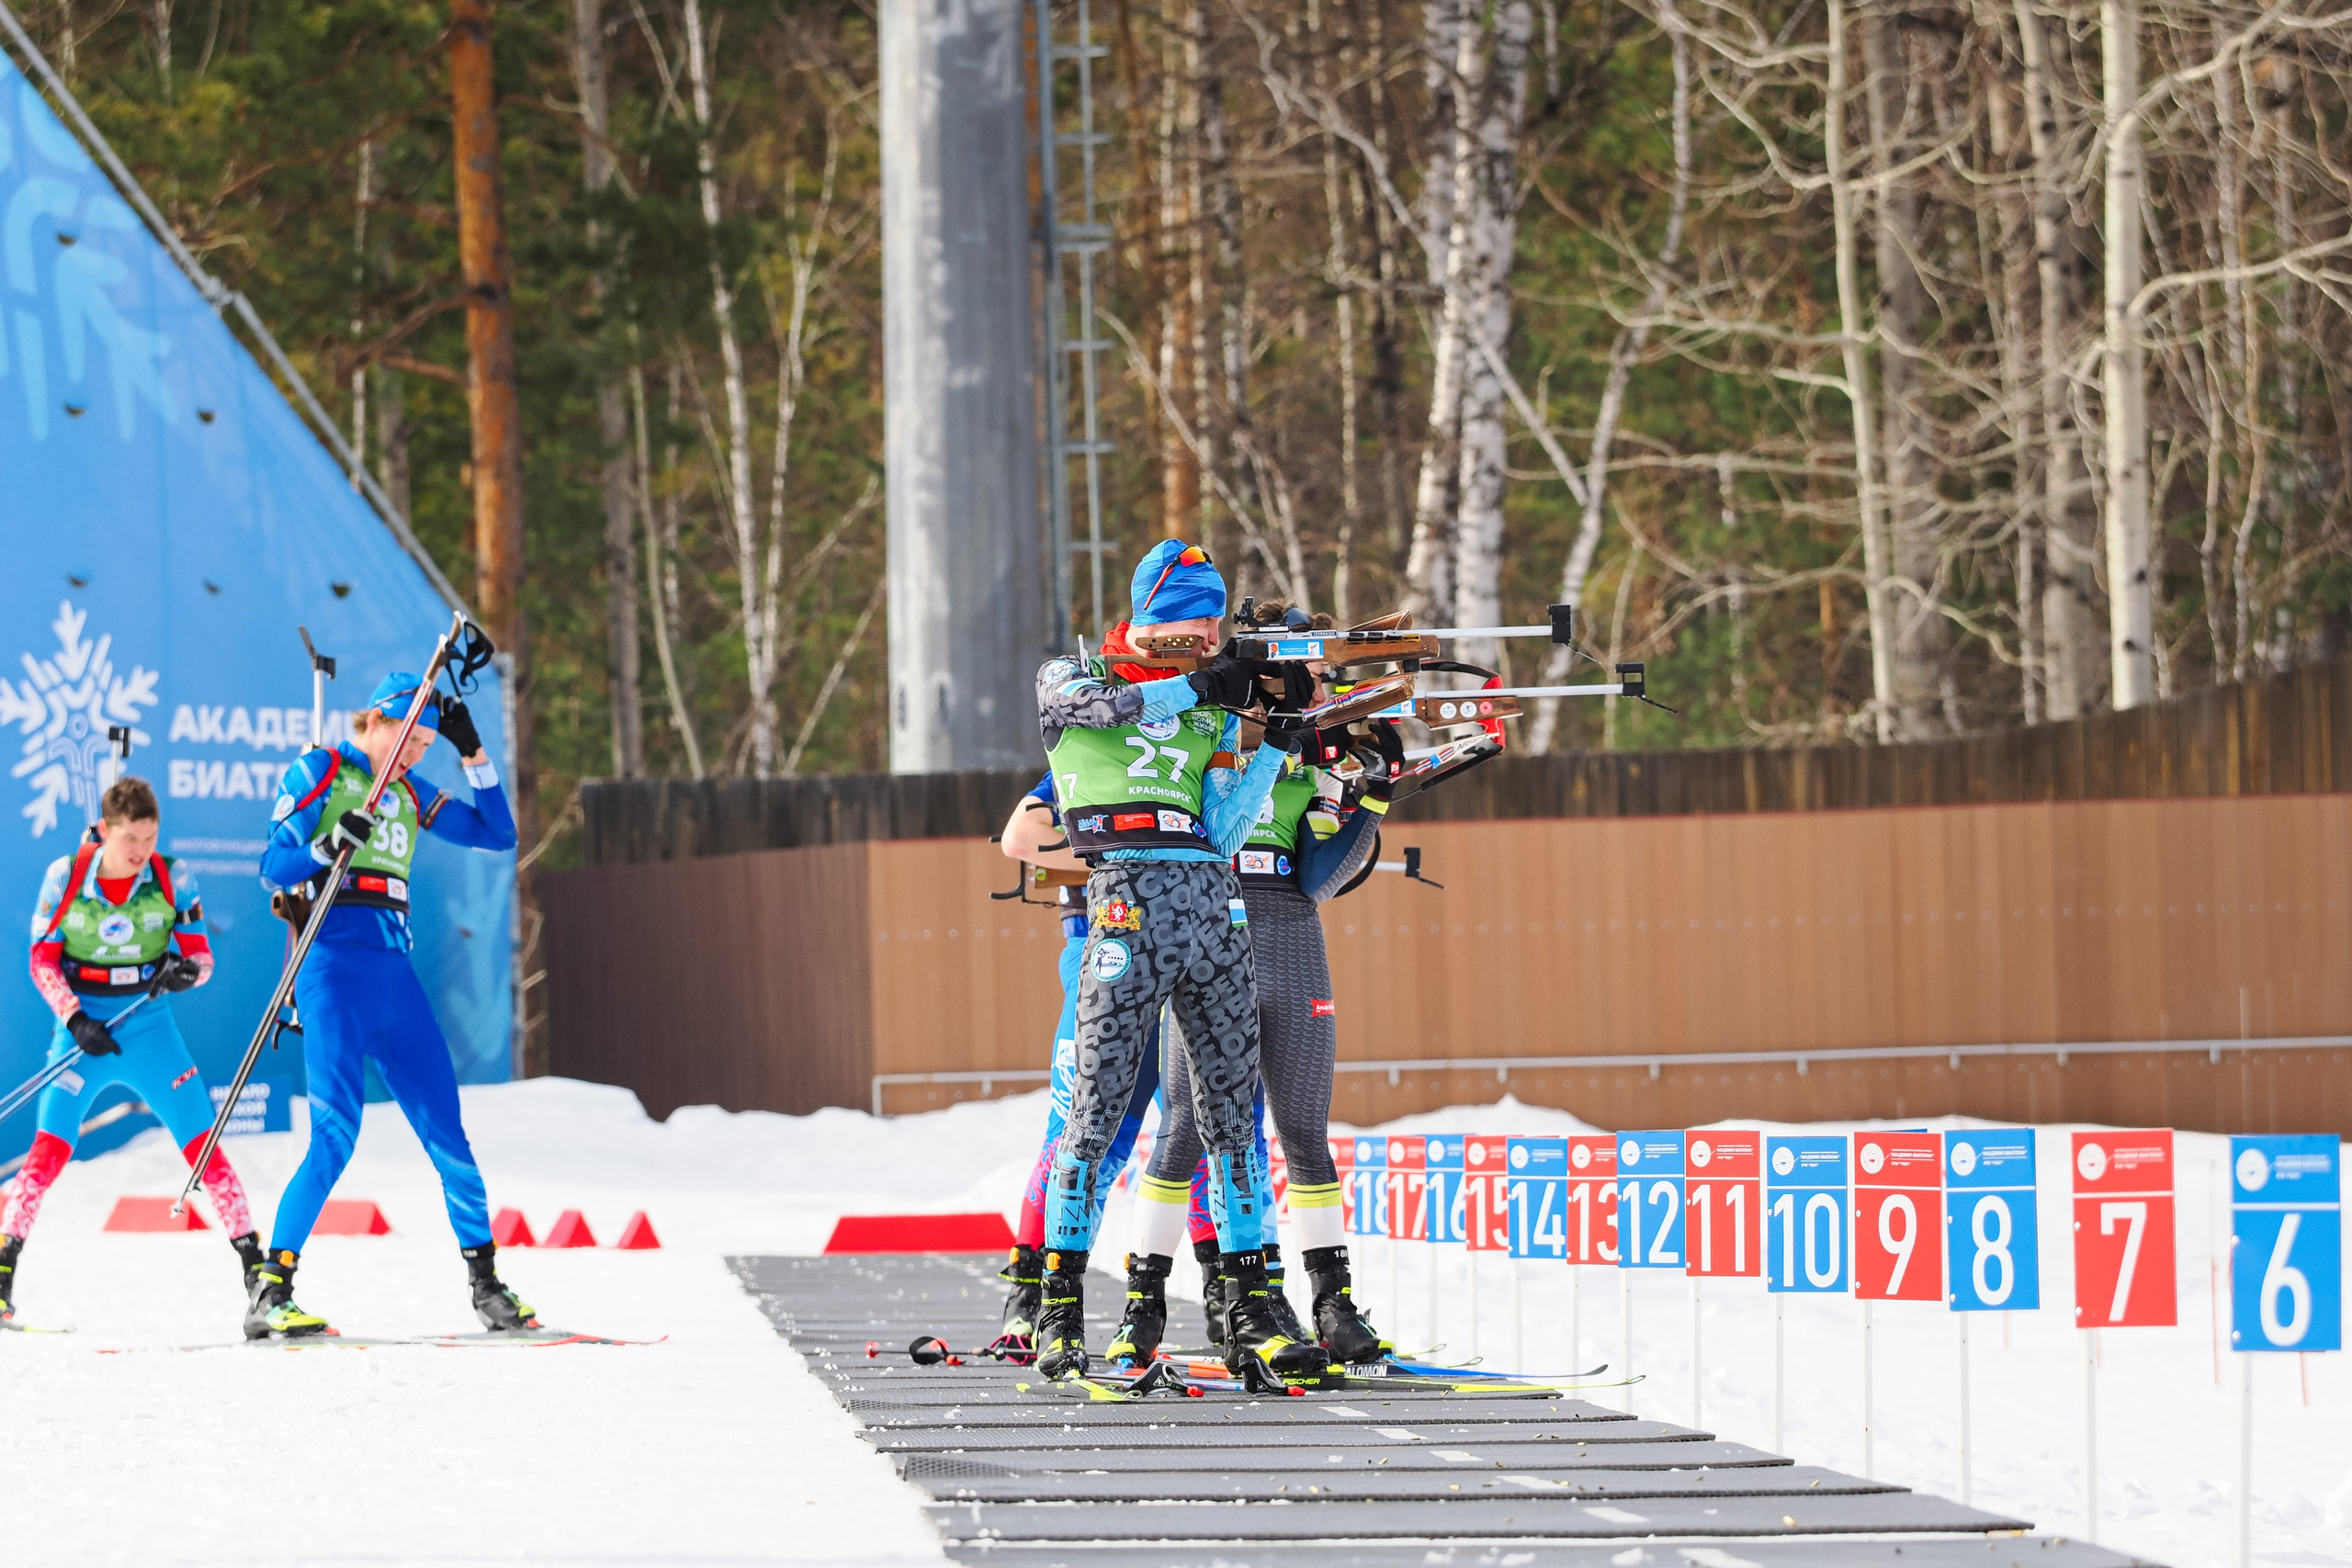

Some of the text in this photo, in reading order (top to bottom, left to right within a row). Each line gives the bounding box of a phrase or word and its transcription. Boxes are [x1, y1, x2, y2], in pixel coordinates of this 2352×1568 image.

[1125, 736, 1190, 784] 27
[1128, 785, 1193, 804] КРАСНОЯРСК
[373, 818, 409, 859] 38
[1356, 1170, 1388, 1234] 18
[1389, 1172, 1427, 1238] 17
[1429, 1172, 1466, 1240] 16
[1468, 1176, 1509, 1247] 15
[1510, 1181, 1566, 1257] 14
[1573, 1182, 1618, 1261] 13
[1622, 1180, 1679, 1264] 12
[1691, 1184, 1746, 1272] 11
[1239, 1255, 1258, 1267] 177
[1773, 1192, 1840, 1288] 10
[1878, 1193, 1917, 1295] 9
[1972, 1194, 2015, 1306] 8
[2100, 1201, 2148, 1322] 7
[2259, 1213, 2313, 1347] 6
[1283, 1378, 1321, 1386] FISCHER
[1345, 1365, 1388, 1378] ALOMON
